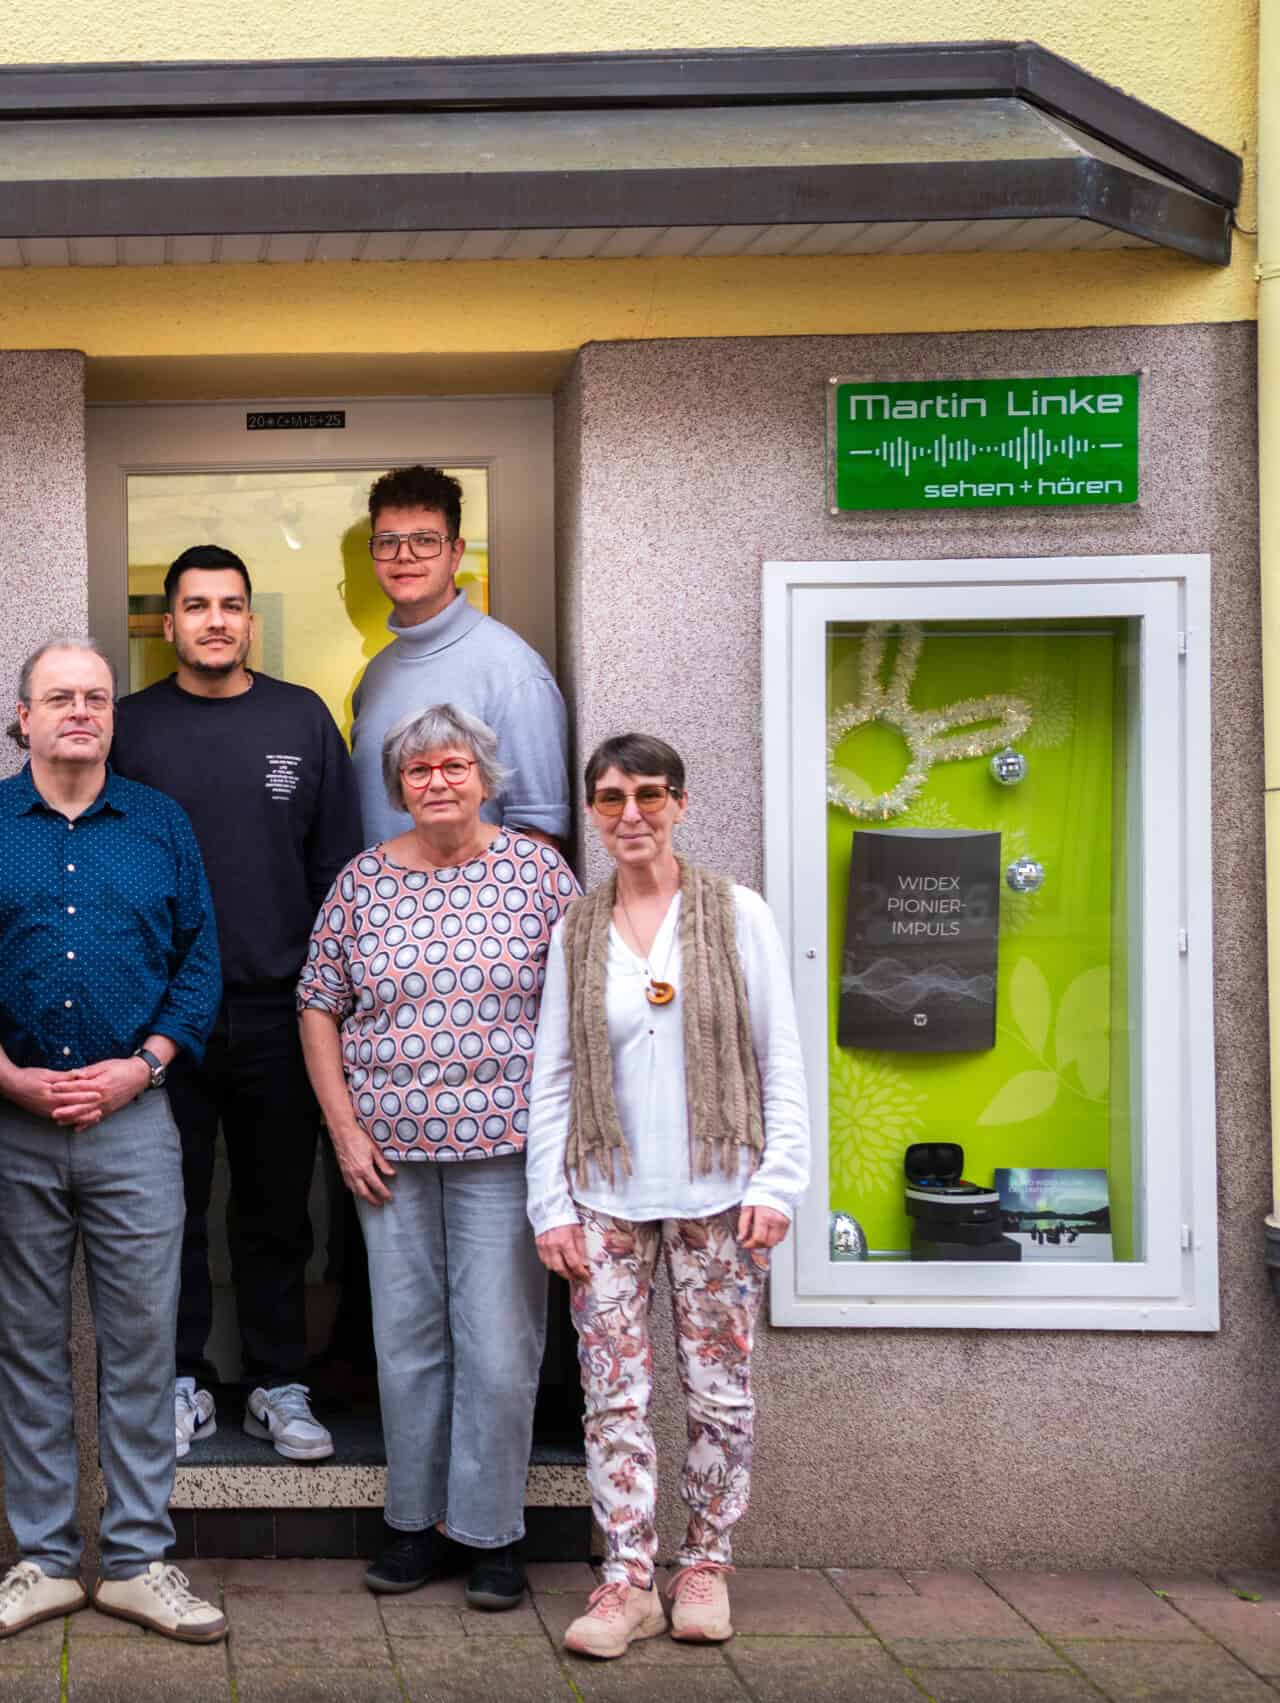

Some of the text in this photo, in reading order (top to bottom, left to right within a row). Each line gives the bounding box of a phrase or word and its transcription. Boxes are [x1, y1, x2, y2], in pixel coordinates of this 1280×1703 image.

[849, 389, 1124, 420] Martin Linke
[897, 875, 961, 892] WIDEX
[887, 898, 968, 913] PIONIER-
[891, 921, 961, 936] IMPULS
